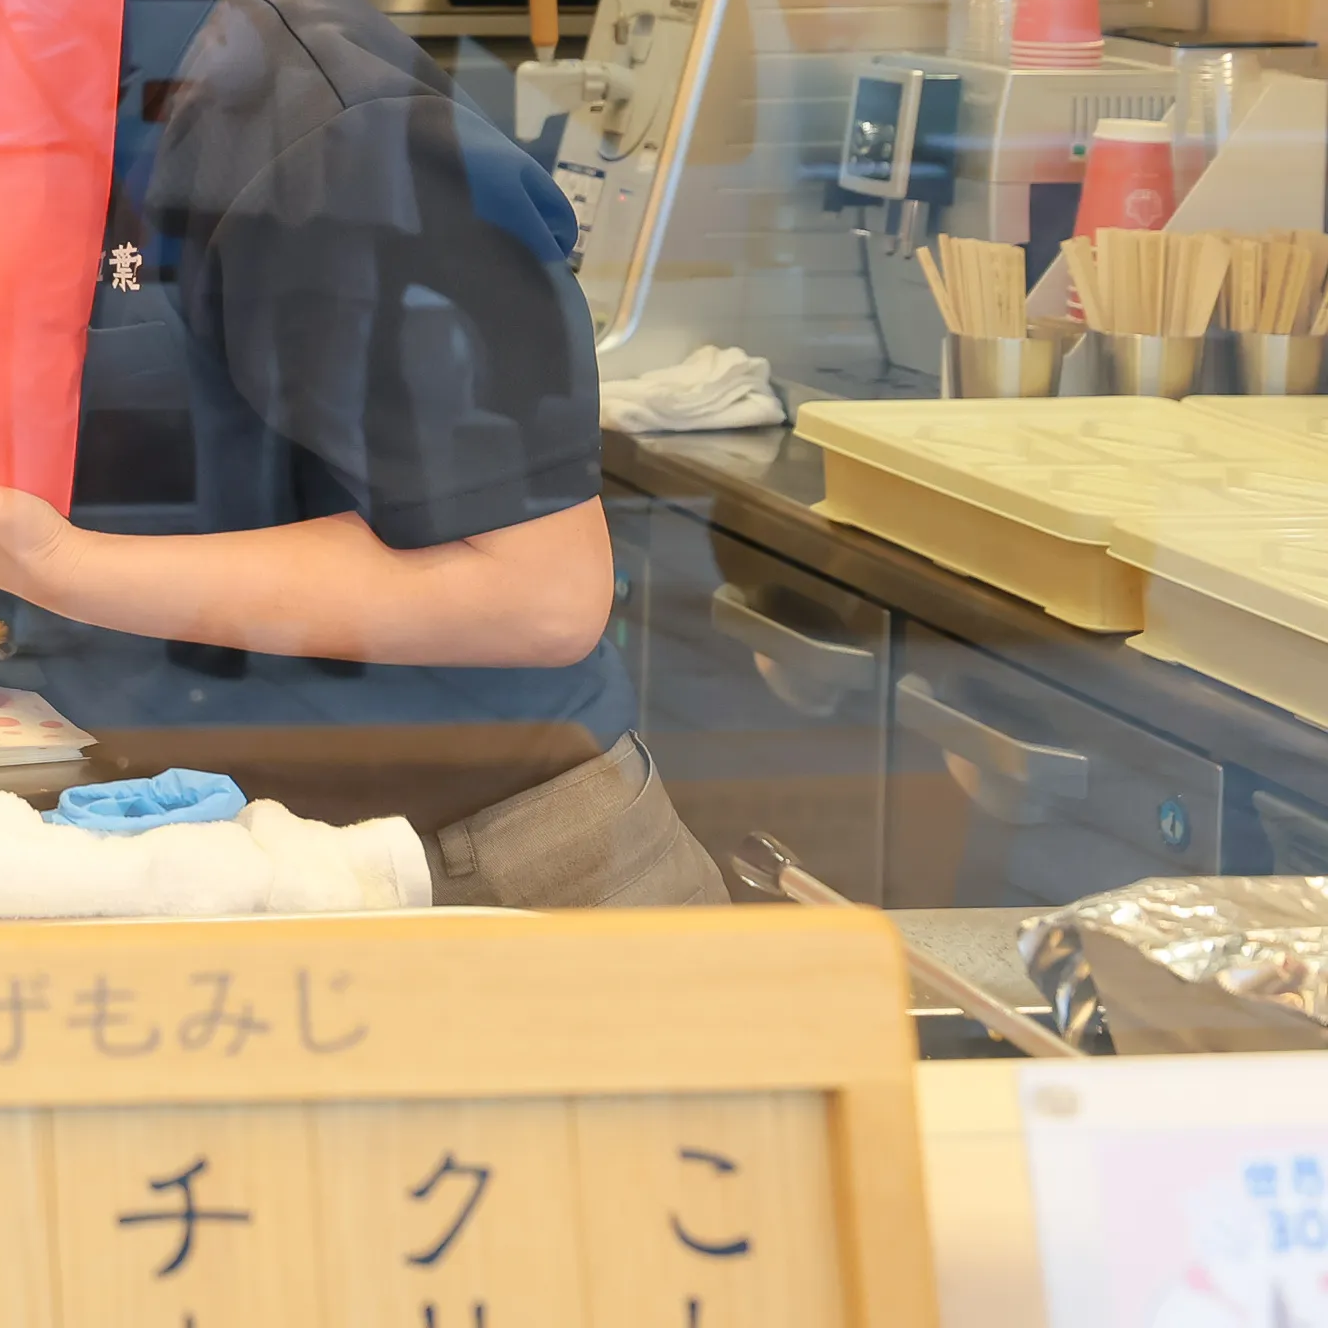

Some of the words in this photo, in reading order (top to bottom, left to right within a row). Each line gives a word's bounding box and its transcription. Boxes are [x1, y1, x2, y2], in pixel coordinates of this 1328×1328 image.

[116, 1156, 254, 1328] チ
[404, 1150, 494, 1328] ク
[667, 1146, 752, 1328] こ
